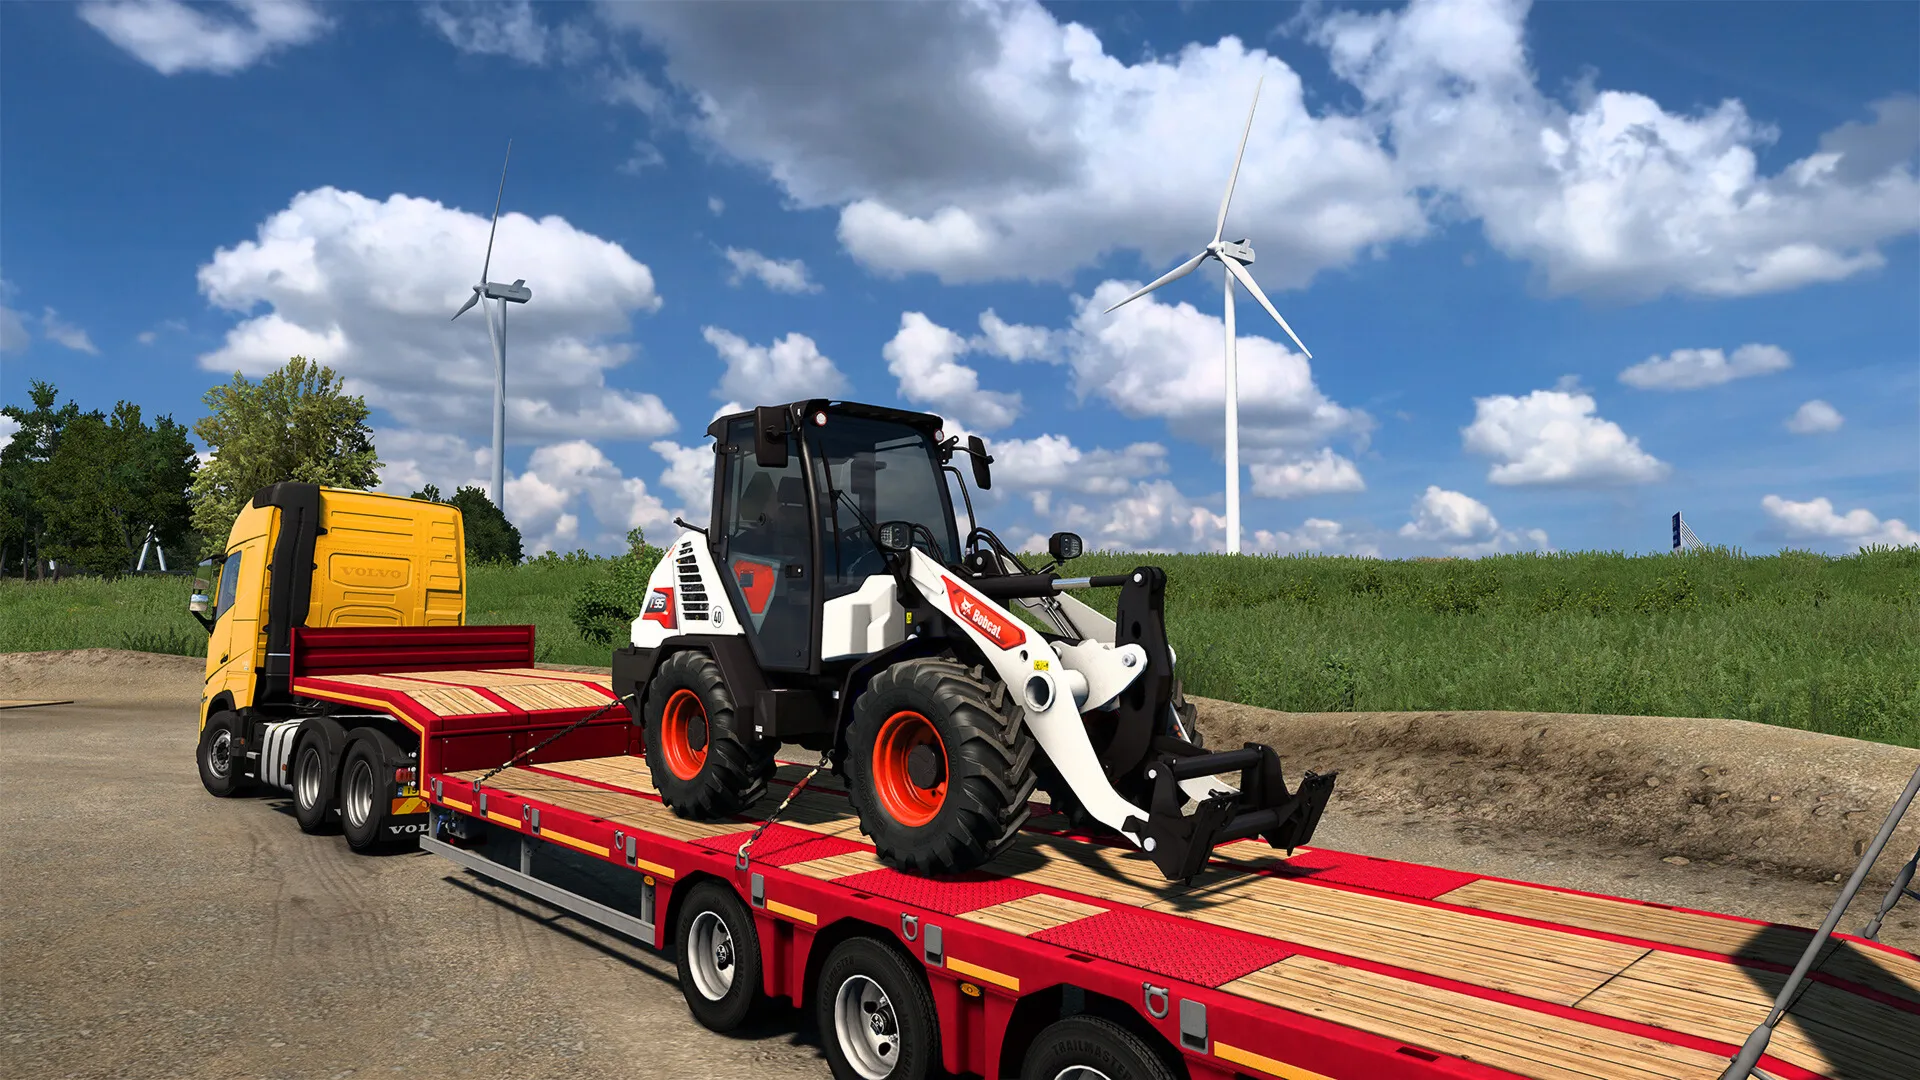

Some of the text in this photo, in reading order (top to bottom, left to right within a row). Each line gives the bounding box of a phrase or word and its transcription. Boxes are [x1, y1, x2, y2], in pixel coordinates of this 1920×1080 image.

[340, 566, 401, 579] VOLVO
[713, 611, 722, 624] 40
[388, 823, 431, 835] VOL
